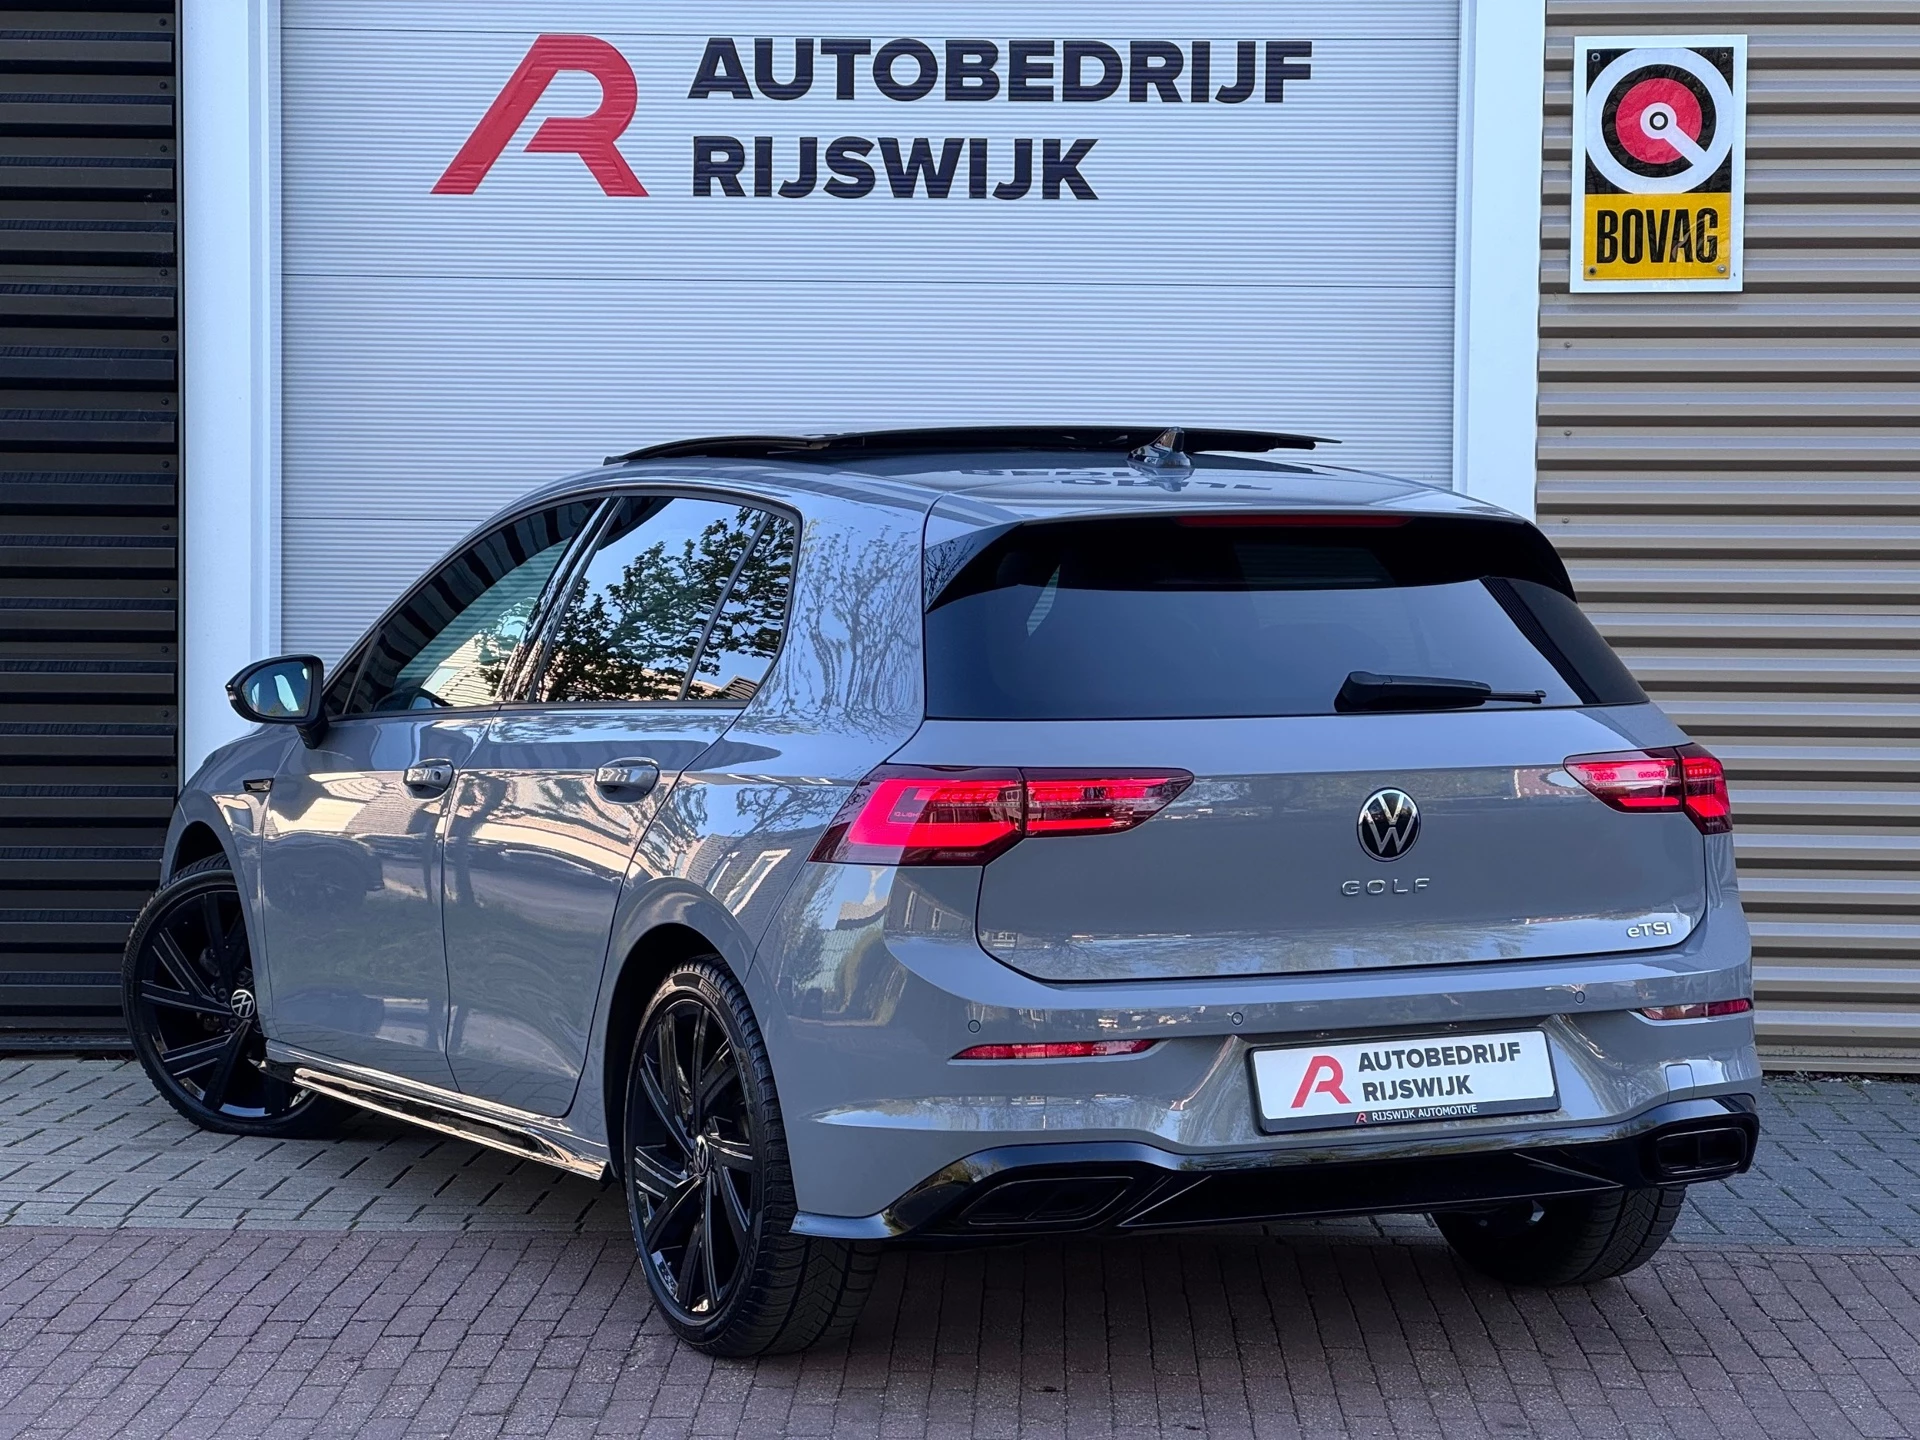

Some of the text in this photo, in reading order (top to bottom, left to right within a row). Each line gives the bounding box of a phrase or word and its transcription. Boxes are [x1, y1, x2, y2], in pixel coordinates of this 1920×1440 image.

[688, 37, 1313, 104] AUTOBEDRIJF
[692, 135, 1099, 201] RIJSWIJK
[1596, 207, 1718, 264] BOVAG
[1341, 877, 1430, 897] GOLF
[1627, 921, 1673, 939] eTSI
[1358, 1041, 1521, 1072] AUTOBEDRIJF
[1362, 1074, 1473, 1102] RIJSWIJK
[1371, 1104, 1478, 1122] RIJSWIJK AUTOMOTIVE
